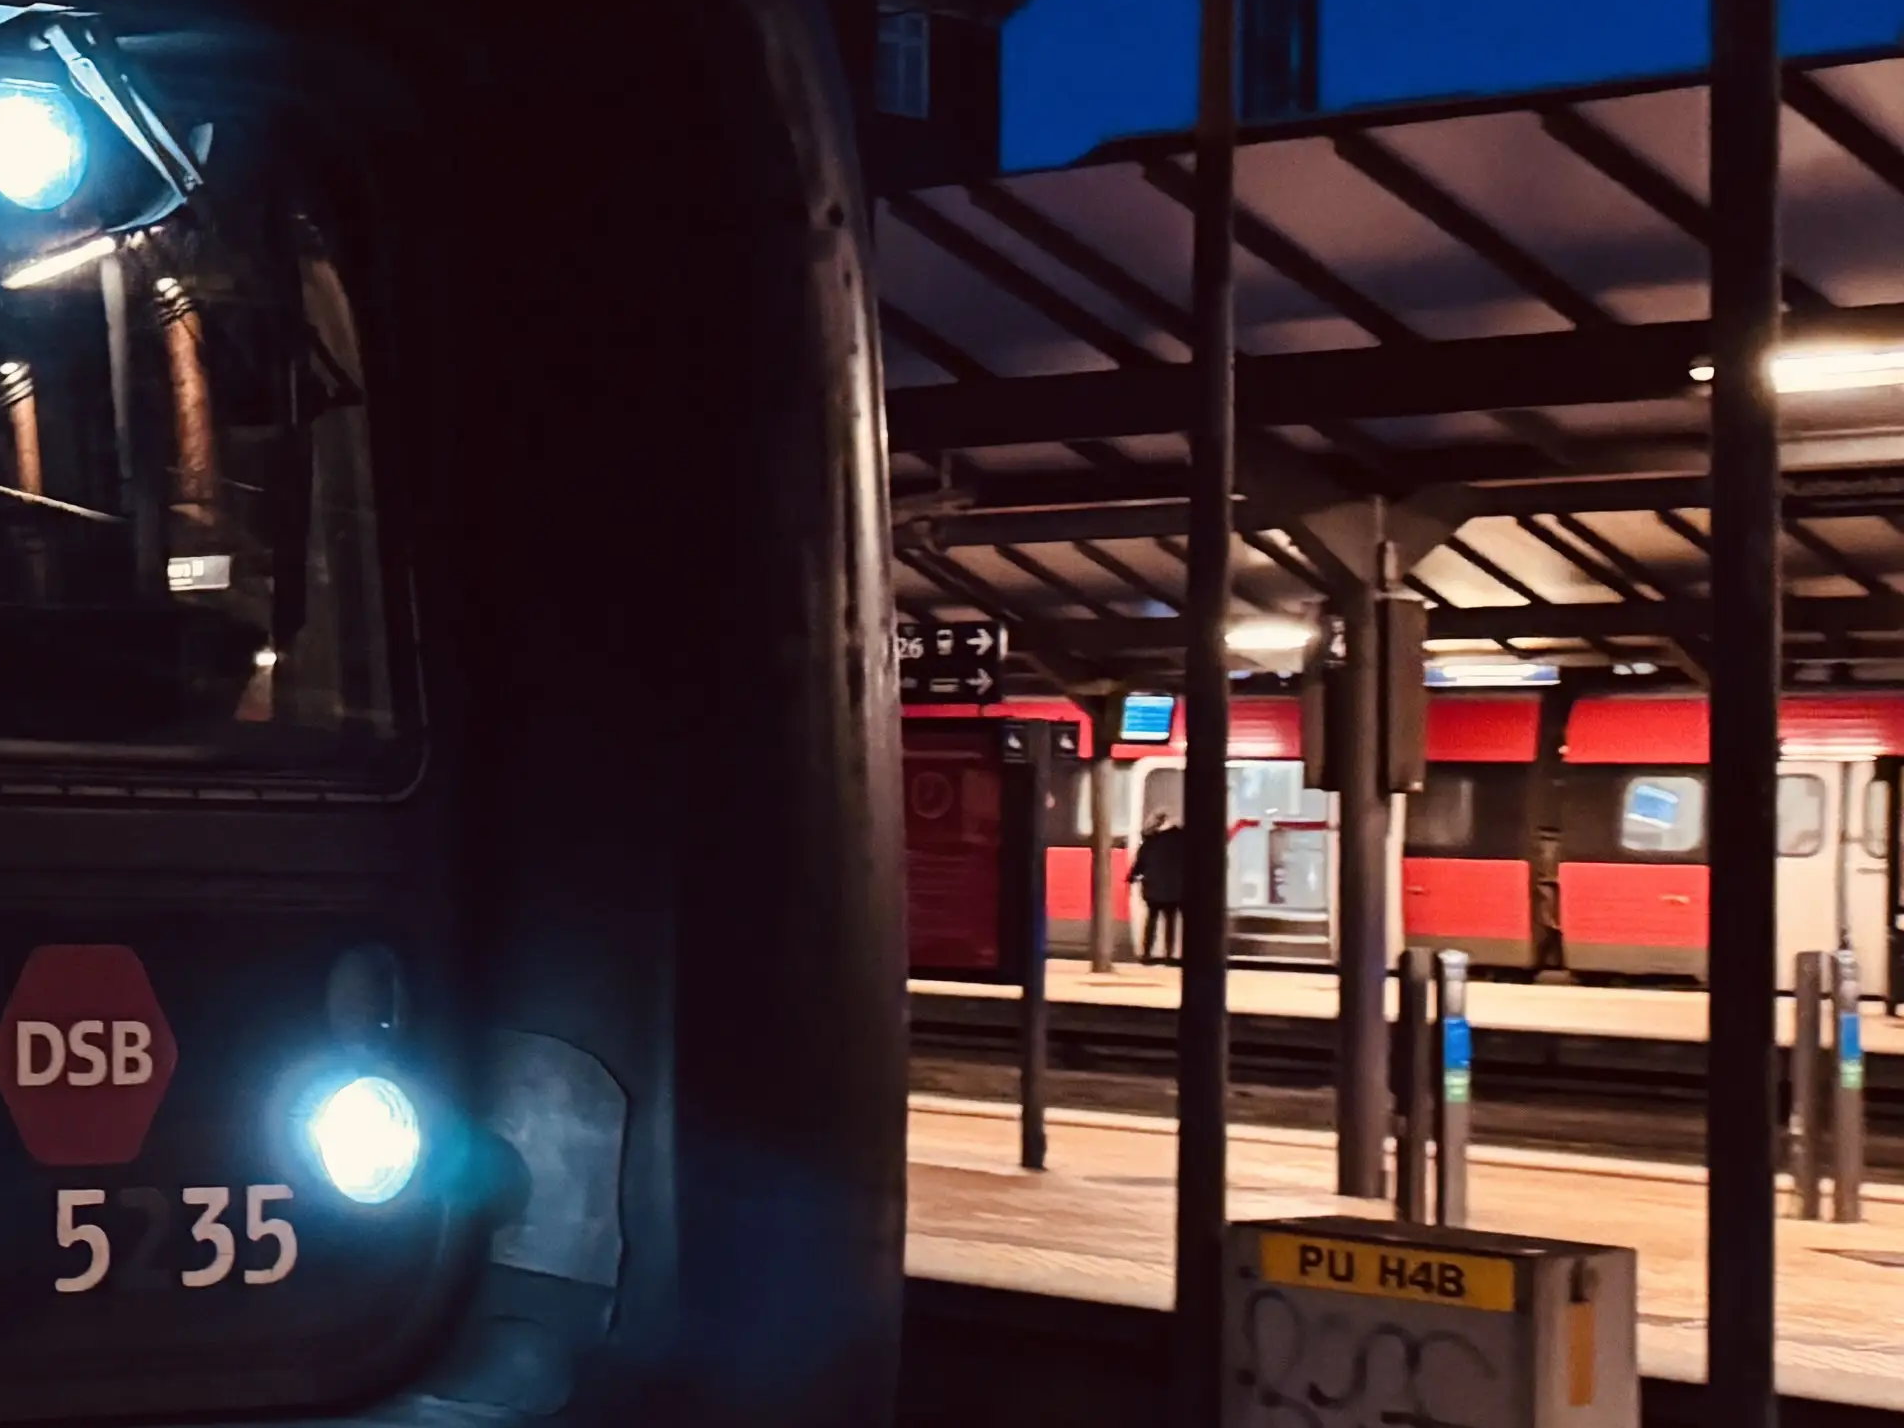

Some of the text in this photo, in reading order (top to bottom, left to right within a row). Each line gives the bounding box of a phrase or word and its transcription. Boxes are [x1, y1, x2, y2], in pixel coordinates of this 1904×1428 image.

[16, 1020, 153, 1086] DSB
[1299, 1245, 1466, 1298] PU H4B
